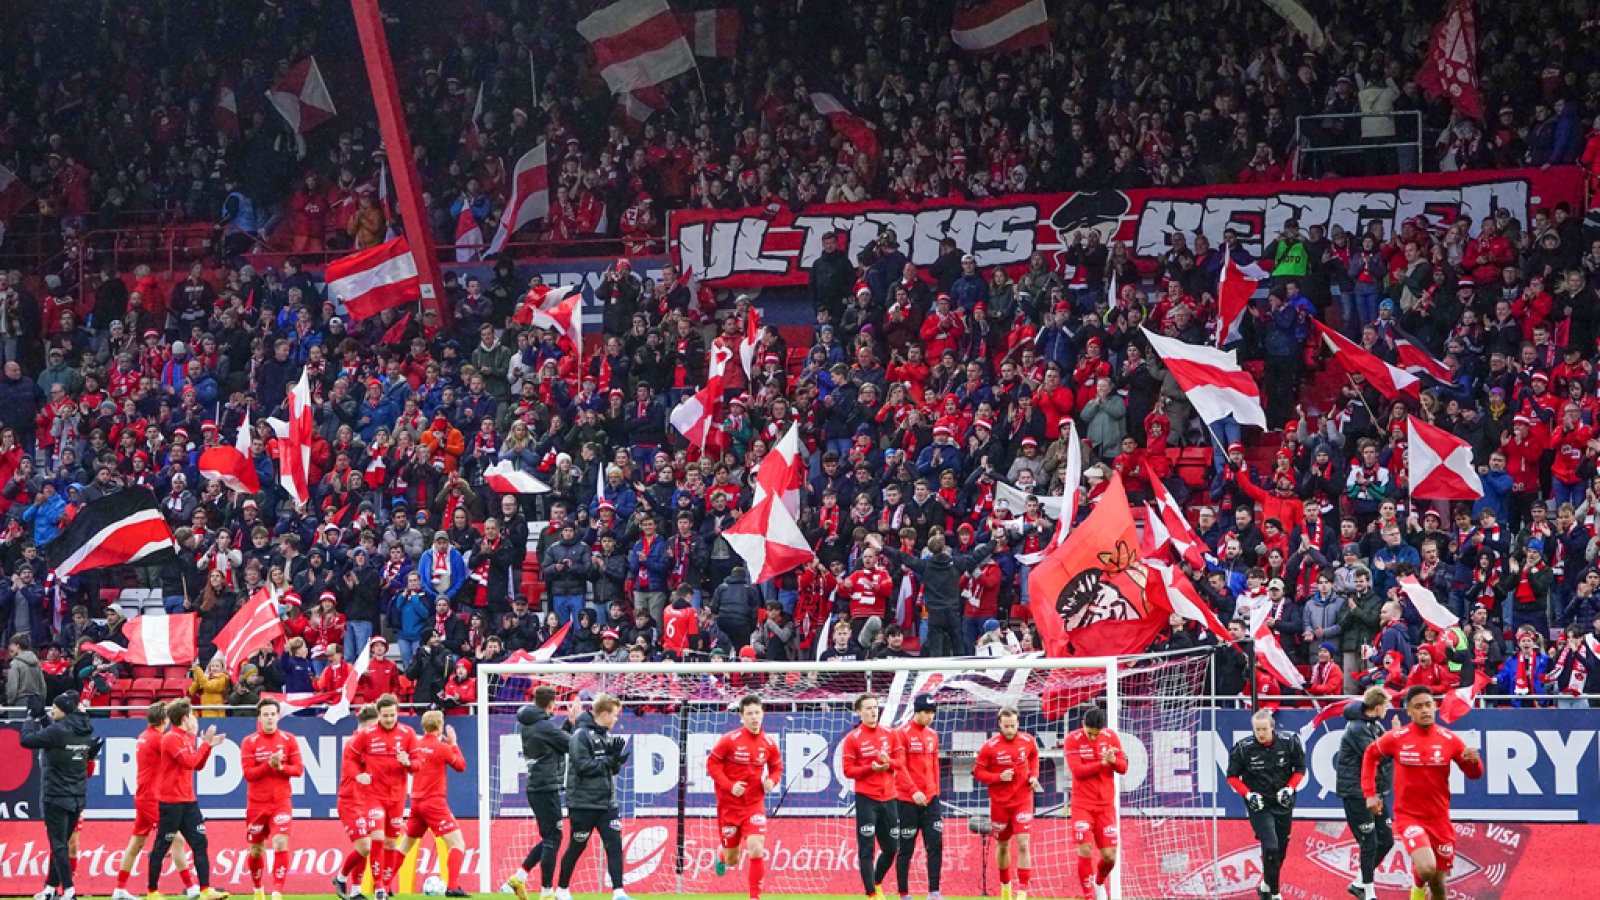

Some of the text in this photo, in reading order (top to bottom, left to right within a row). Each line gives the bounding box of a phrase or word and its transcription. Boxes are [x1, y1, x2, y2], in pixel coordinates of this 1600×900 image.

[666, 617, 676, 638] 6
[1448, 730, 1600, 794] FRY
[1486, 823, 1520, 848] VISA
